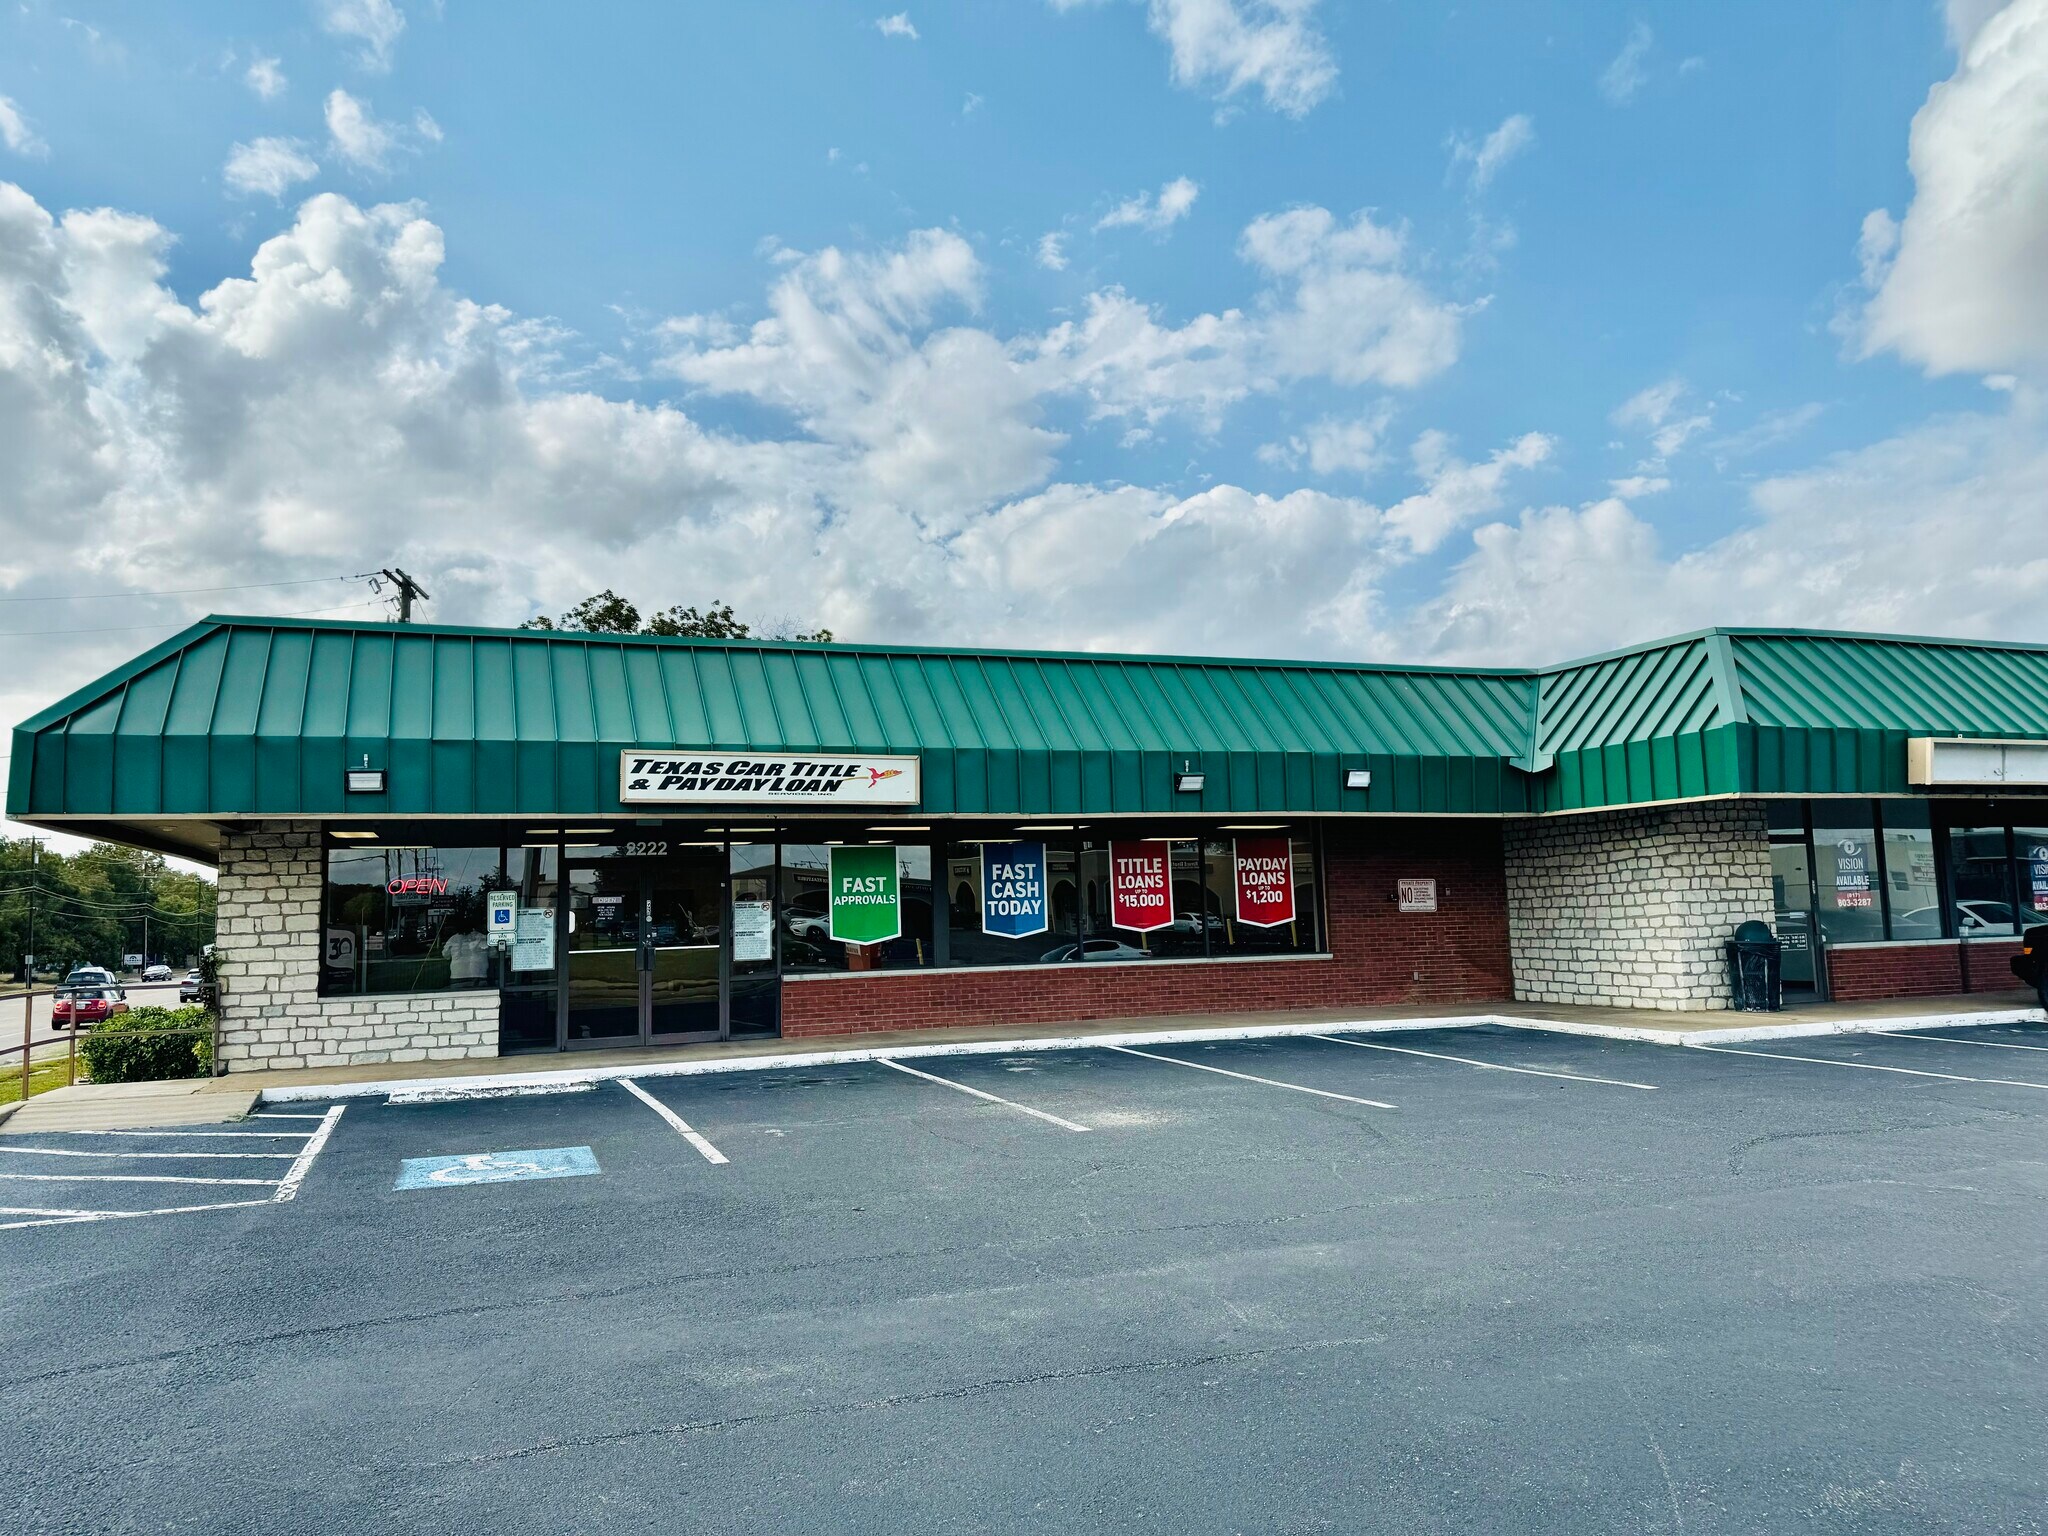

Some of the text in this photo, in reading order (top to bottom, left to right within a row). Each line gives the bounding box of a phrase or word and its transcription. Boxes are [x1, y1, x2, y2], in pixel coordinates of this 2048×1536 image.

[630, 759, 861, 777] TEXAS CAR TITLE
[627, 775, 845, 792] & PAYDAY LOAN
[626, 841, 668, 856] 2222
[1117, 858, 1163, 874] TITLE
[1238, 857, 1288, 871] PAYDAY
[1838, 858, 1864, 869] VISION
[992, 864, 1037, 880] FAST
[1242, 872, 1286, 886] LOANS
[387, 878, 448, 895] OPEN
[842, 876, 887, 893] FAST
[1118, 875, 1164, 889] LOANS
[1836, 875, 1870, 886] AVAILABLE
[991, 881, 1040, 899] CASH
[1246, 890, 1283, 904] $1,200
[1401, 887, 1413, 903] NO
[833, 894, 896, 906] APPROVALS
[1119, 893, 1164, 907] $15,000
[987, 900, 1042, 916] TODAY
